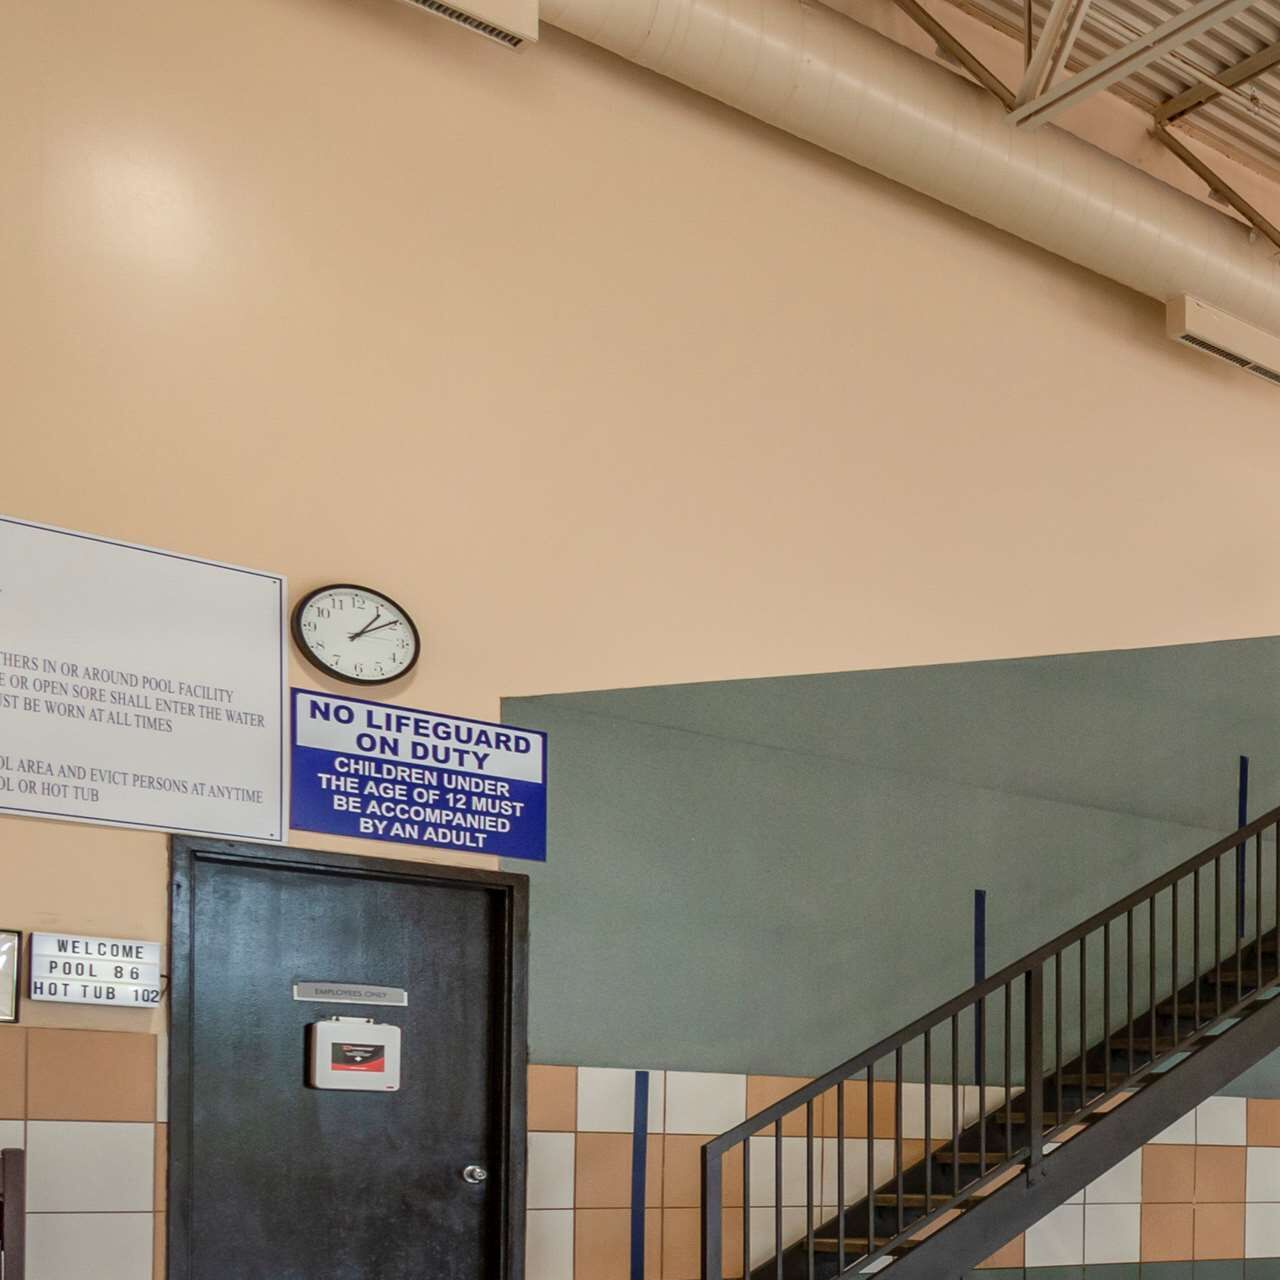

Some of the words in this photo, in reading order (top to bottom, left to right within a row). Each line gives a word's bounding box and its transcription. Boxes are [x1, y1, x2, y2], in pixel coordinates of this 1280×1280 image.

[316, 606, 331, 619] 10
[331, 598, 344, 611] 11
[351, 597, 366, 610] 12
[43, 658, 57, 674] IN
[61, 662, 79, 678] OR
[83, 667, 139, 688] AROUND
[142, 675, 175, 695] POOL
[179, 682, 234, 704] FACILITY
[10, 674, 29, 690] OR
[33, 678, 69, 697] OPEN
[72, 684, 107, 703] SORE
[110, 690, 152, 711] SHALL
[155, 697, 196, 718] ENTER
[198, 704, 222, 722] THE
[225, 709, 265, 729] WATER
[23, 696, 41, 713] BE
[44, 700, 85, 720] WORN
[89, 707, 105, 723] AT
[107, 710, 132, 728] ALL
[134, 713, 173, 733] TIMES
[310, 699, 355, 725] NO
[366, 709, 532, 755] LIFEGUARD
[356, 732, 399, 757] ON
[411, 741, 491, 771] DUTY
[16, 758, 54, 778] AREA
[58, 764, 86, 782] AND
[90, 767, 129, 787] EVICT
[132, 773, 189, 794] PERSONS
[191, 781, 207, 798] AT
[208, 784, 264, 804] ANYTIME
[18, 778, 37, 795] OR
[41, 781, 69, 799] HOT
[73, 785, 100, 803] TUB
[317, 772, 359, 794] THE
[364, 780, 408, 802] AGE
[412, 787, 440, 805] OF
[445, 792, 467, 809] 12
[471, 796, 525, 817] MUST
[334, 756, 438, 787] CHILDREN
[443, 774, 510, 798] UNDER
[333, 795, 362, 814] BE
[365, 800, 511, 834] ACCOMPANIED
[359, 817, 388, 835] BY
[390, 822, 419, 840] AN
[423, 827, 487, 849] ADULT
[57, 938, 144, 960] WELCOME
[49, 960, 97, 978] POOL
[33, 981, 70, 997] HOT
[81, 984, 116, 1000] TUB
[133, 988, 160, 1003] 102
